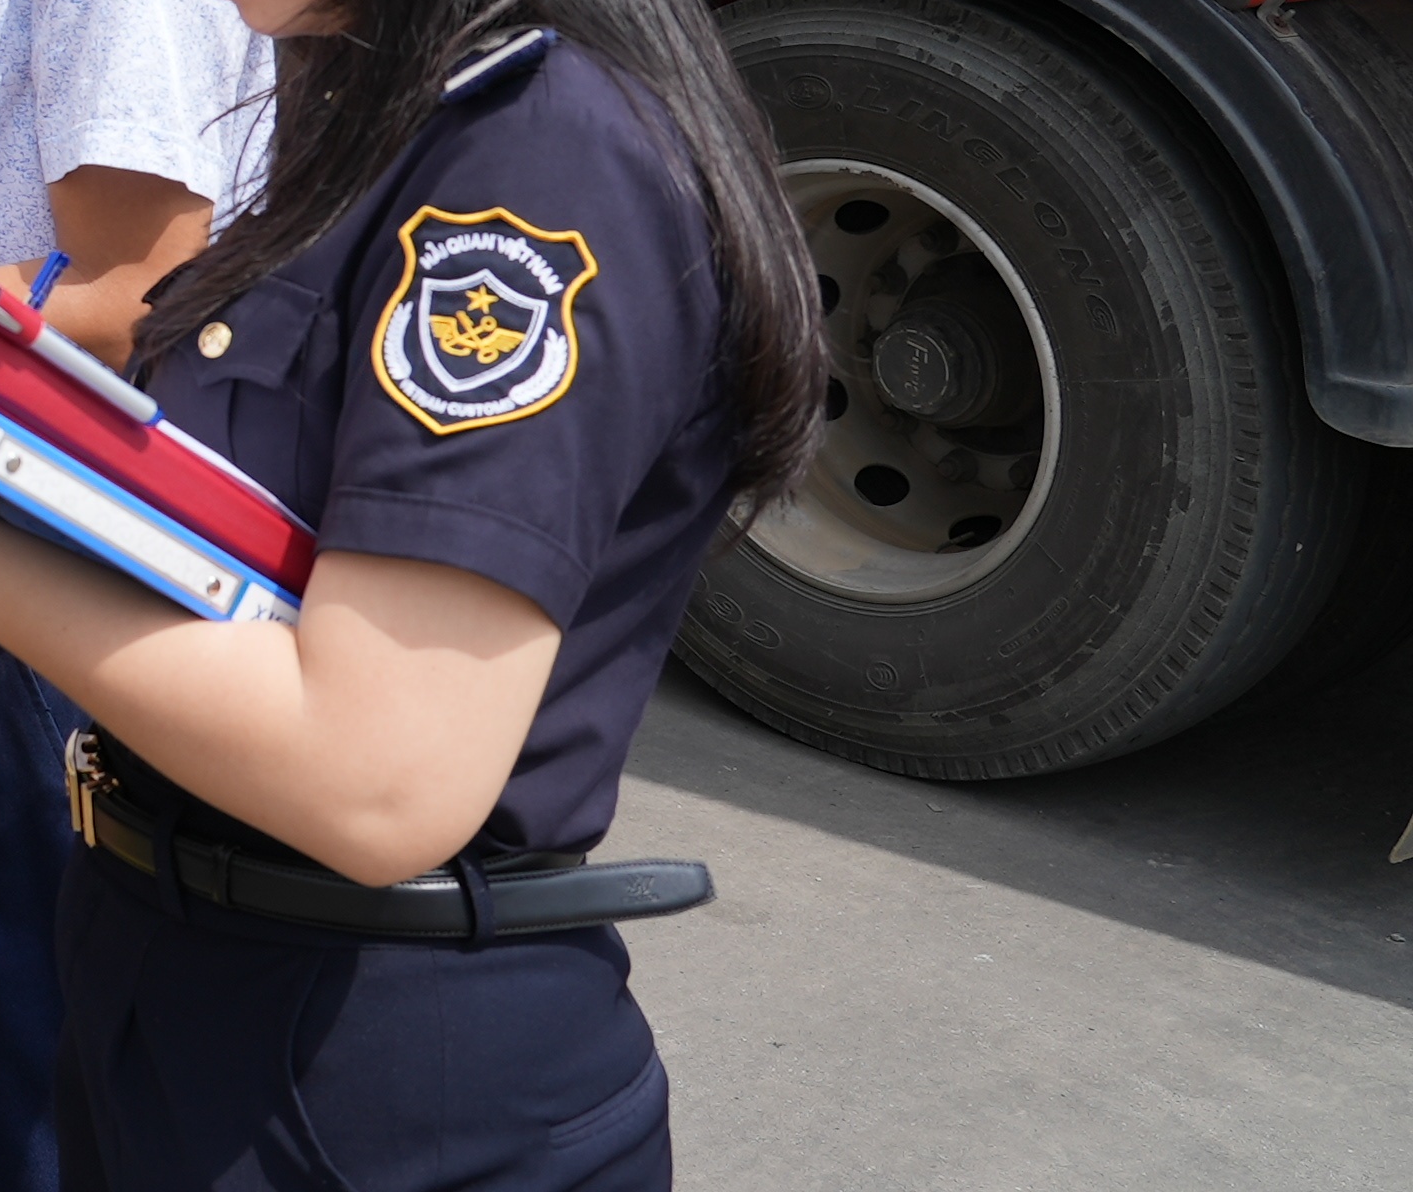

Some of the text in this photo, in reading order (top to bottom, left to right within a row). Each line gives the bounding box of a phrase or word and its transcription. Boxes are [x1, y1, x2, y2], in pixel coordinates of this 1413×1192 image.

[445, 232, 496, 255] QUAN
[526, 254, 564, 297] NAM
[854, 84, 1118, 339] LINGLONG
